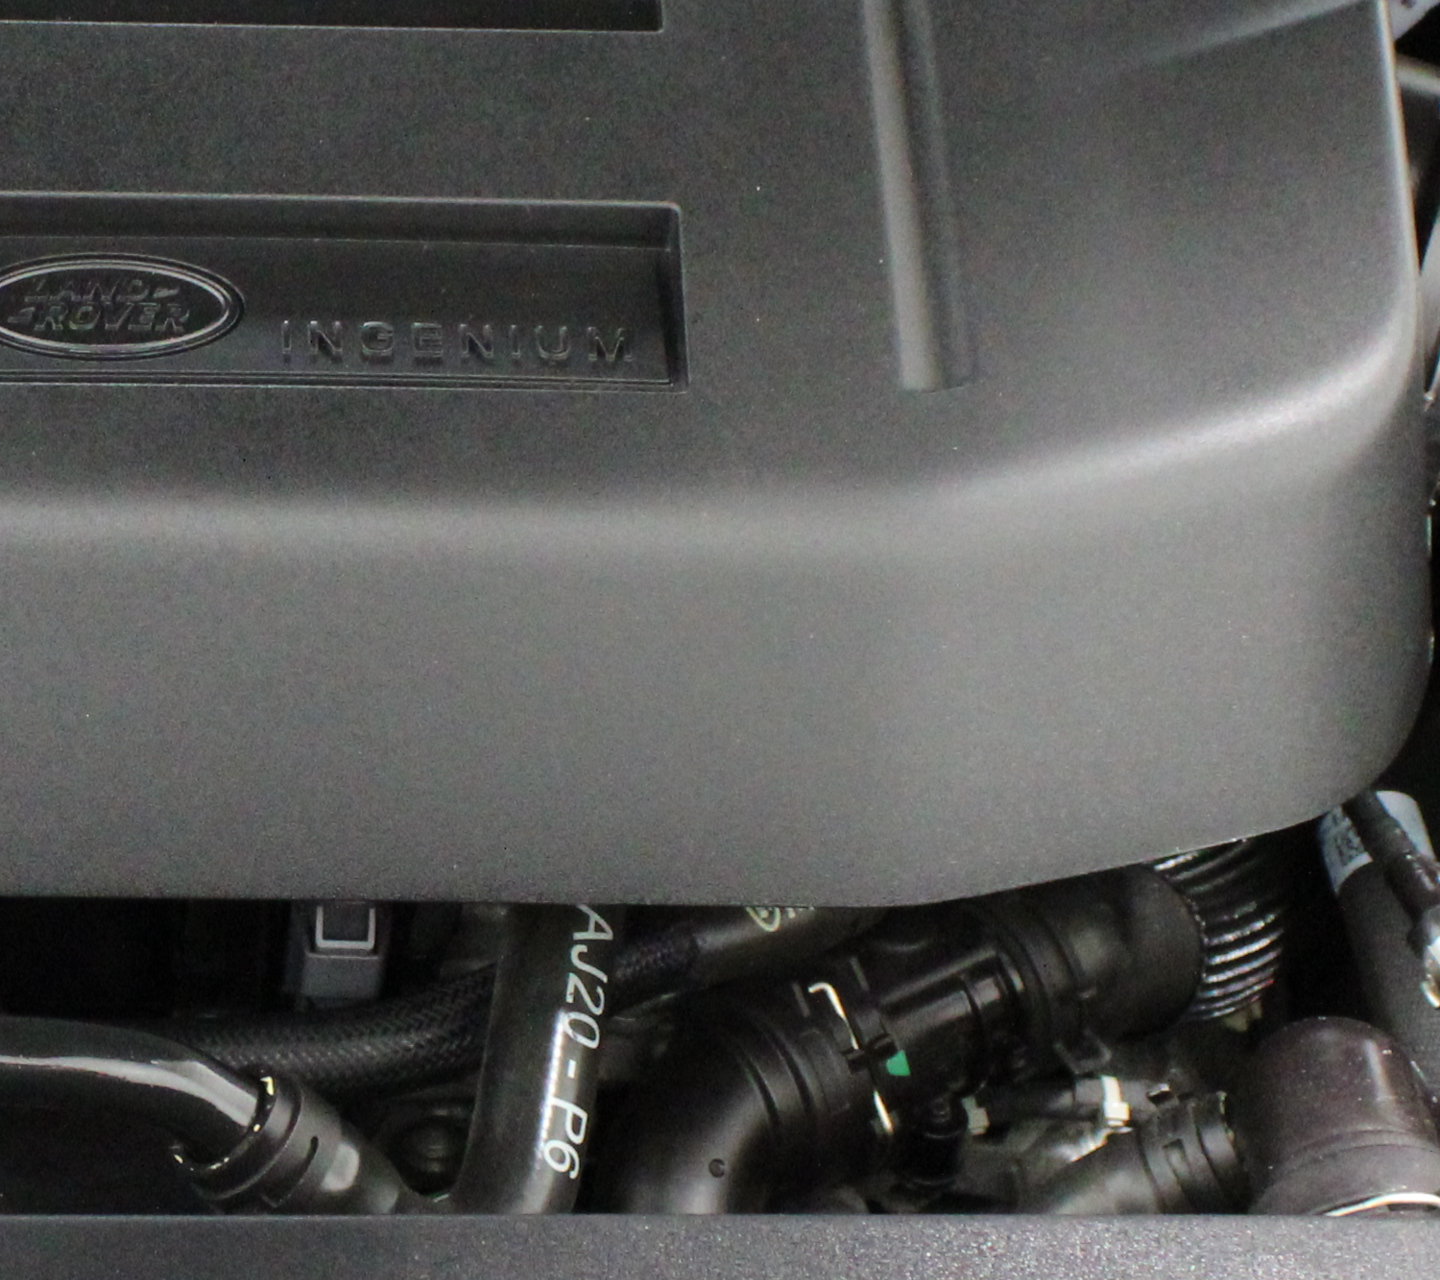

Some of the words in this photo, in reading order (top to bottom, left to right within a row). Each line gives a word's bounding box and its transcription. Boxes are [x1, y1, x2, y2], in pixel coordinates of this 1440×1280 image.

[24, 276, 152, 301] LAND
[31, 302, 190, 332] ROVER
[280, 319, 634, 364] INGENIUM
[565, 904, 614, 1050] AJ20
[543, 1095, 589, 1180] P6
